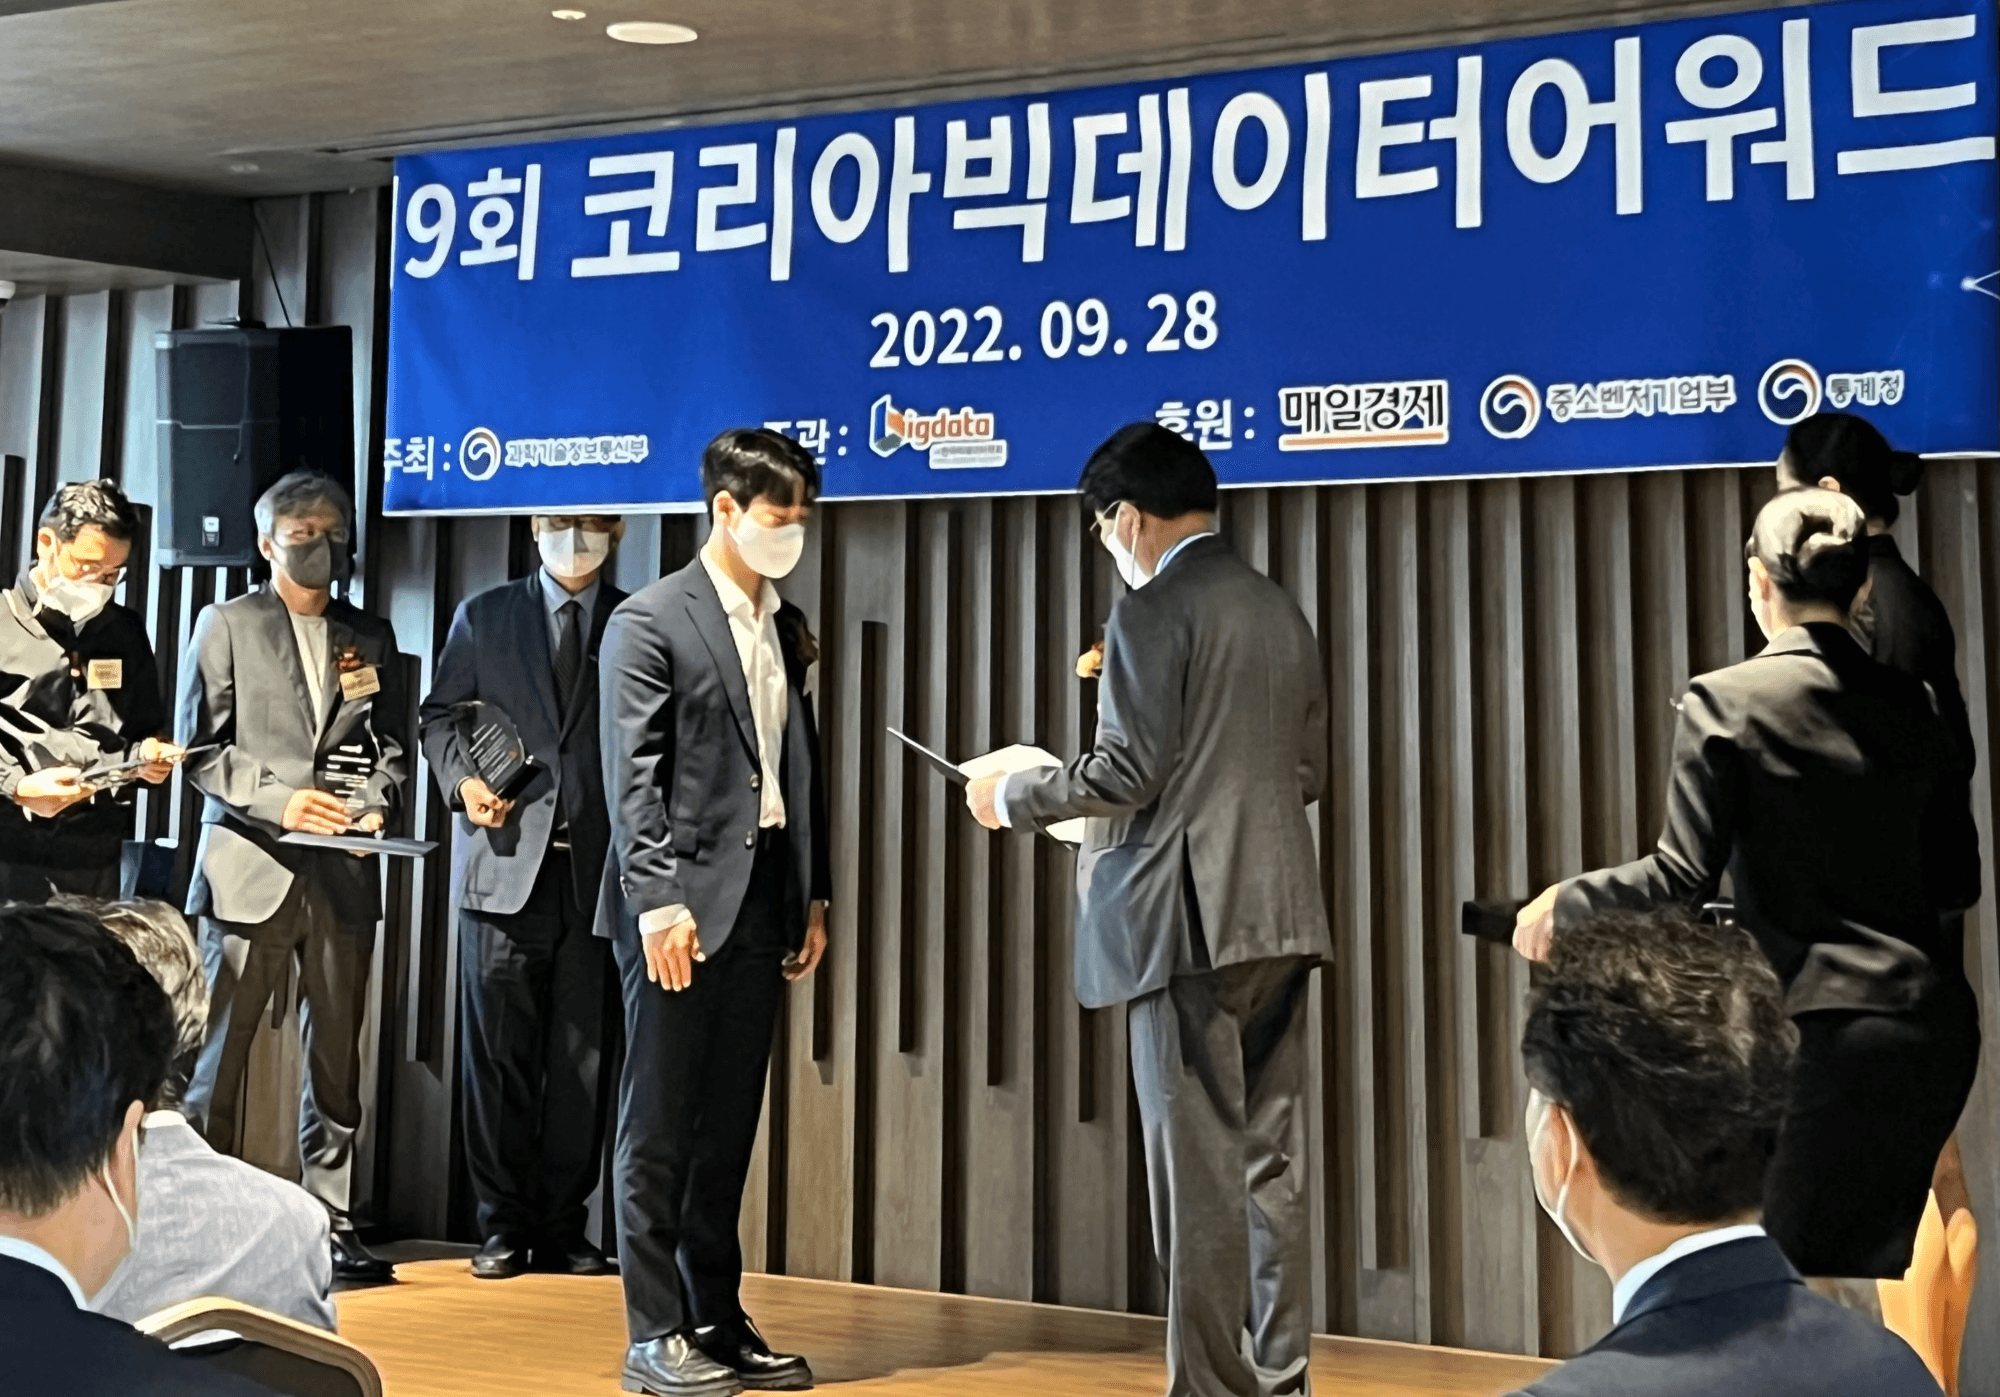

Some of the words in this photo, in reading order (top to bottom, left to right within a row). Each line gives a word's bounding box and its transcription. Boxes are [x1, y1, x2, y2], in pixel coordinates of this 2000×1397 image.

[404, 164, 541, 281] 9회
[869, 305, 1022, 368] 2022.
[1040, 298, 1128, 358] 09.
[1146, 290, 1219, 352] 28
[1284, 384, 1444, 433] 매일경제
[1549, 380, 1734, 417] 중소벤처기업부
